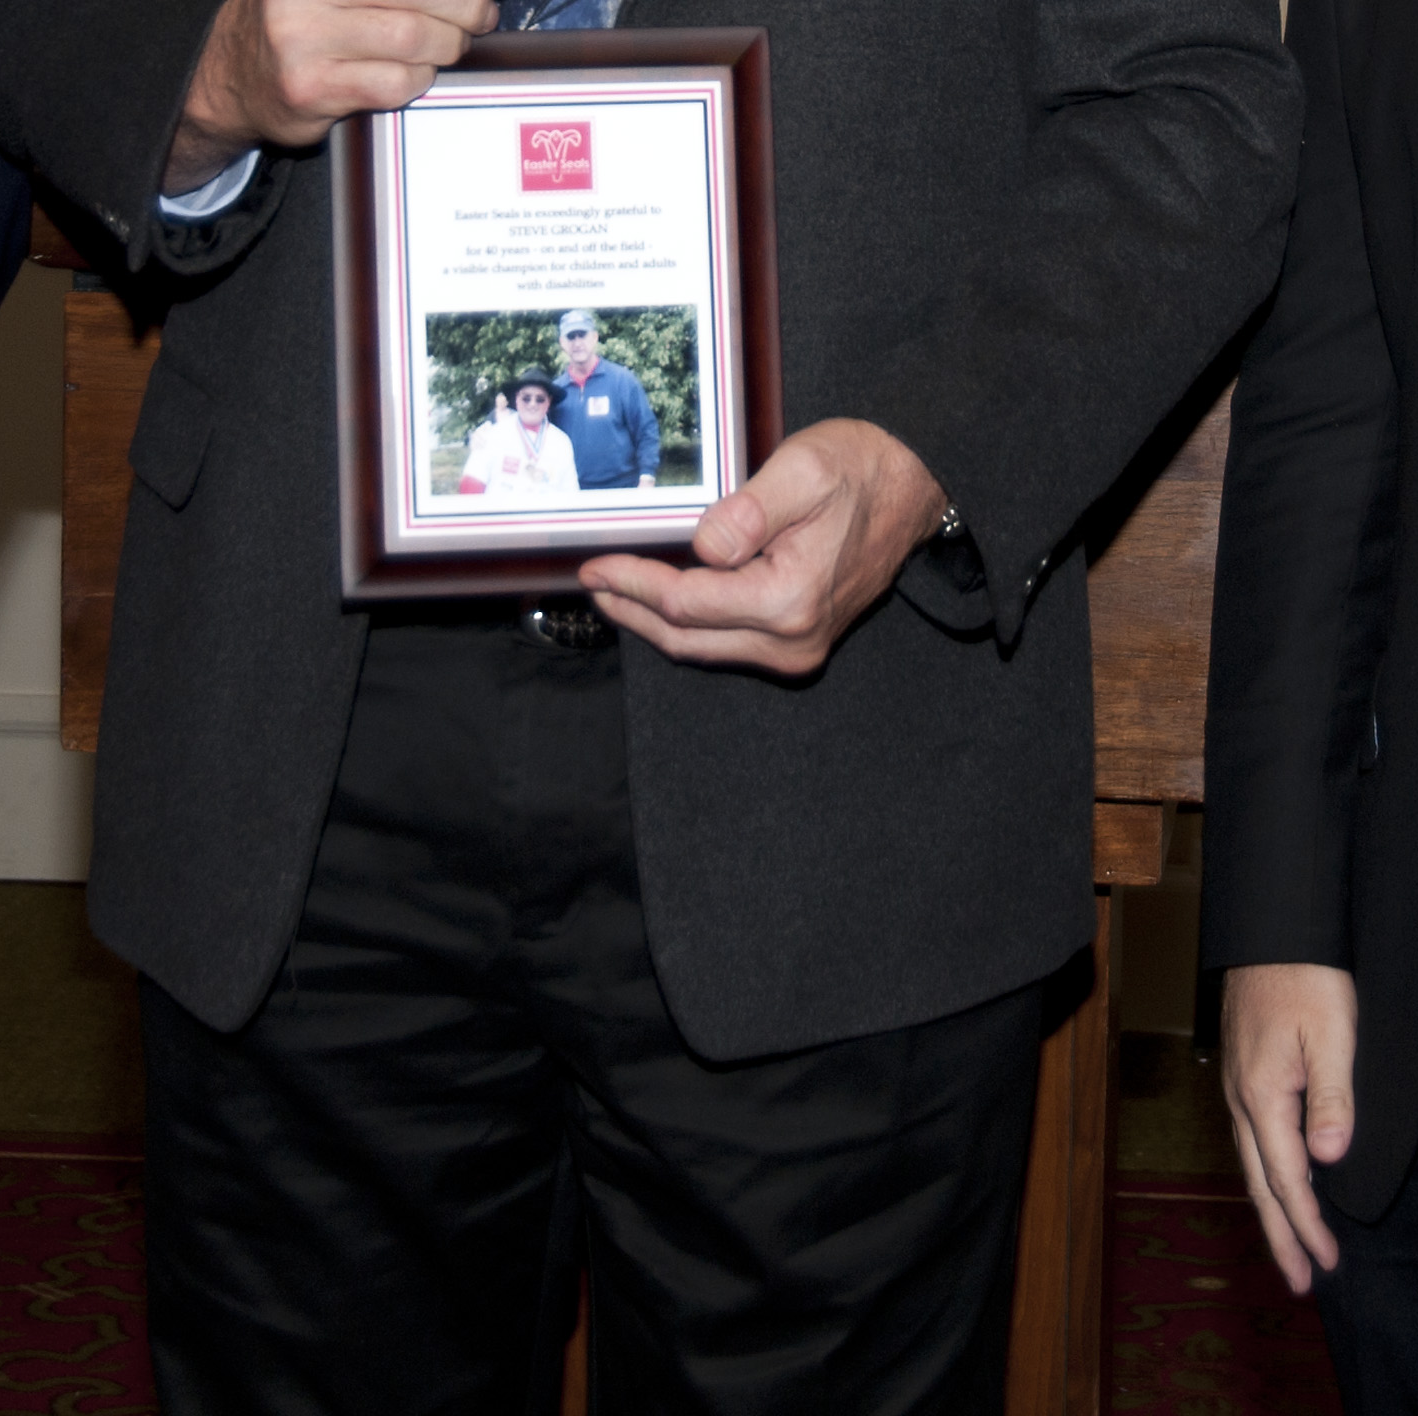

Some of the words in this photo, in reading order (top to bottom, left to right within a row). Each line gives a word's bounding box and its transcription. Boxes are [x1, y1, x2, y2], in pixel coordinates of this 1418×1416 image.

[454, 209, 488, 220] Easter
[492, 208, 520, 219] Seals
[523, 209, 532, 218] is
[534, 207, 600, 219] exceedingly
[604, 204, 647, 219] grateful
[650, 205, 662, 215] to
[509, 225, 548, 236] STEVE
[550, 223, 608, 235] GROGAN
[465, 245, 481, 256] for
[485, 245, 498, 255] 40
[501, 246, 530, 258] years
[541, 246, 555, 254] on
[558, 242, 579, 253] and
[581, 241, 597, 252] off
[600, 240, 617, 252] the
[620, 239, 646, 252] field
[452, 263, 488, 274] visible
[491, 261, 547, 275] champion
[550, 259, 566, 271] for
[569, 258, 615, 271] children
[618, 258, 639, 269] and
[641, 256, 677, 269] adults
[517, 279, 542, 290] with
[544, 277, 605, 290] disabilities
